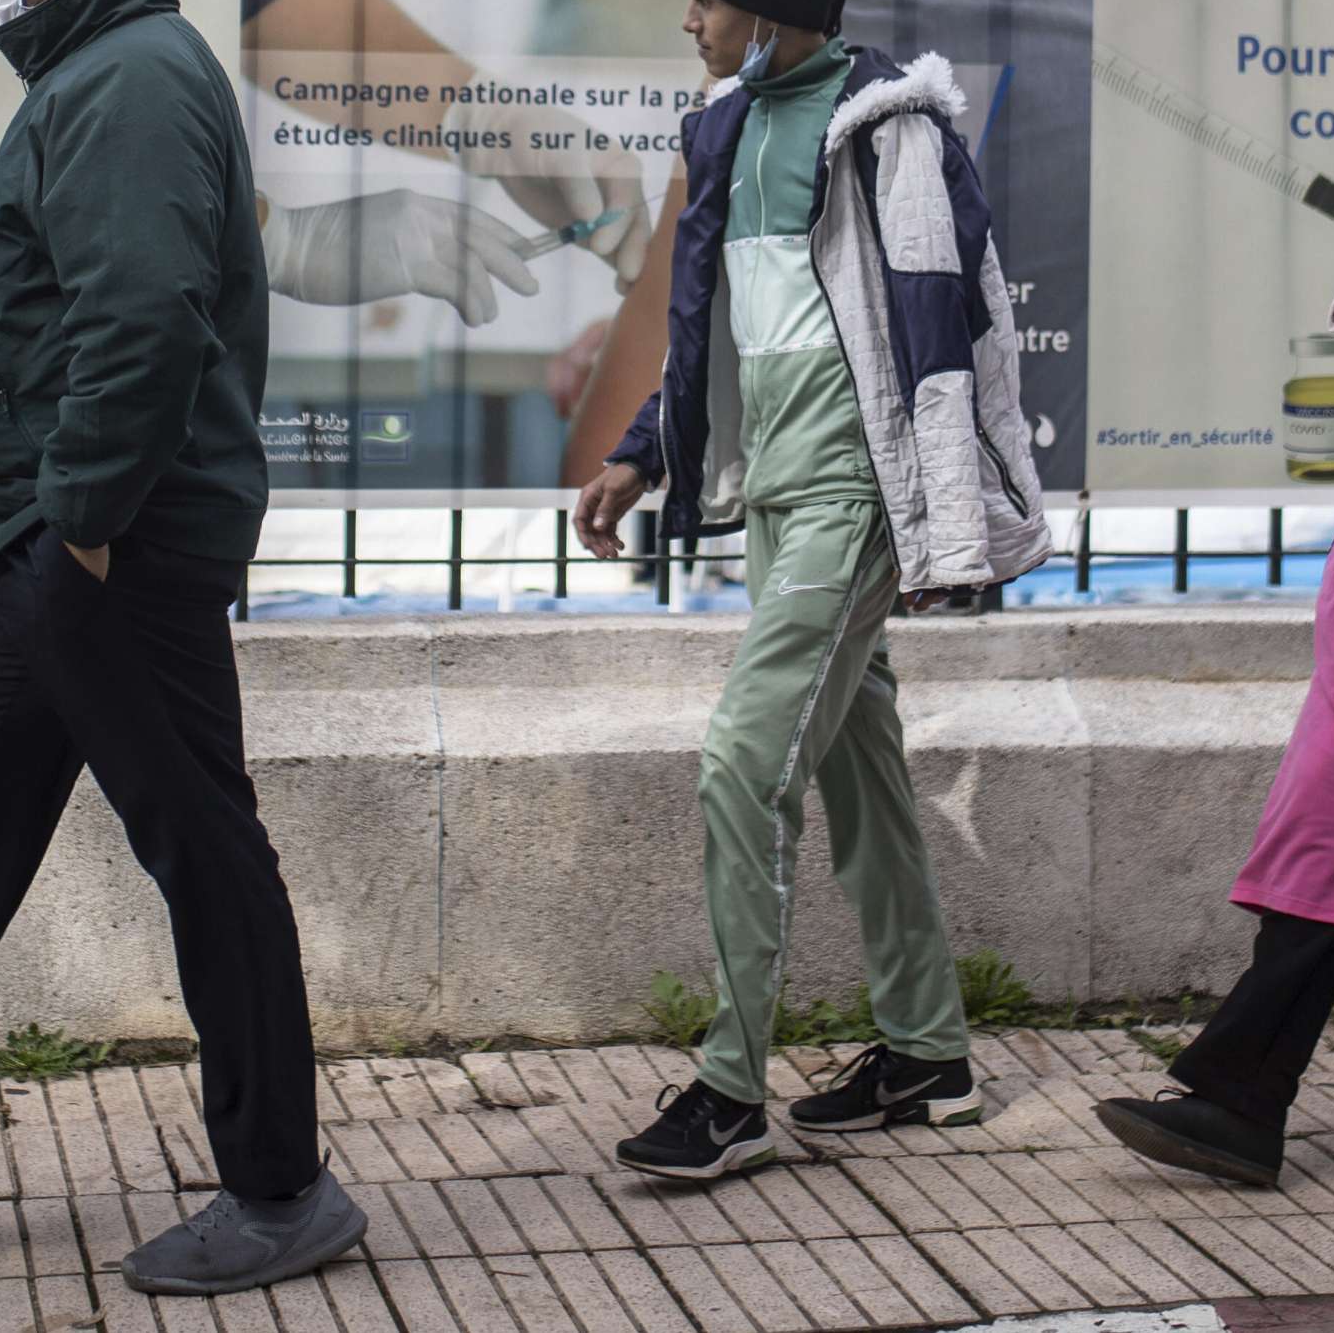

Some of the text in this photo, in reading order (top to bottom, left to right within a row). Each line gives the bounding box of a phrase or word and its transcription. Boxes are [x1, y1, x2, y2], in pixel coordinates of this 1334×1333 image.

[274, 76, 431, 108] Campagne
[439, 78, 576, 107] nationale
[585, 88, 630, 108] sur
[640, 83, 664, 109] la
[273, 120, 683, 154] études cliniques sur le vacc
[258, 411, 350, 433] وزارة الصحة
[1096, 426, 1275, 450] #Sortir_en_sécurité
[266, 449, 300, 463] inistère
